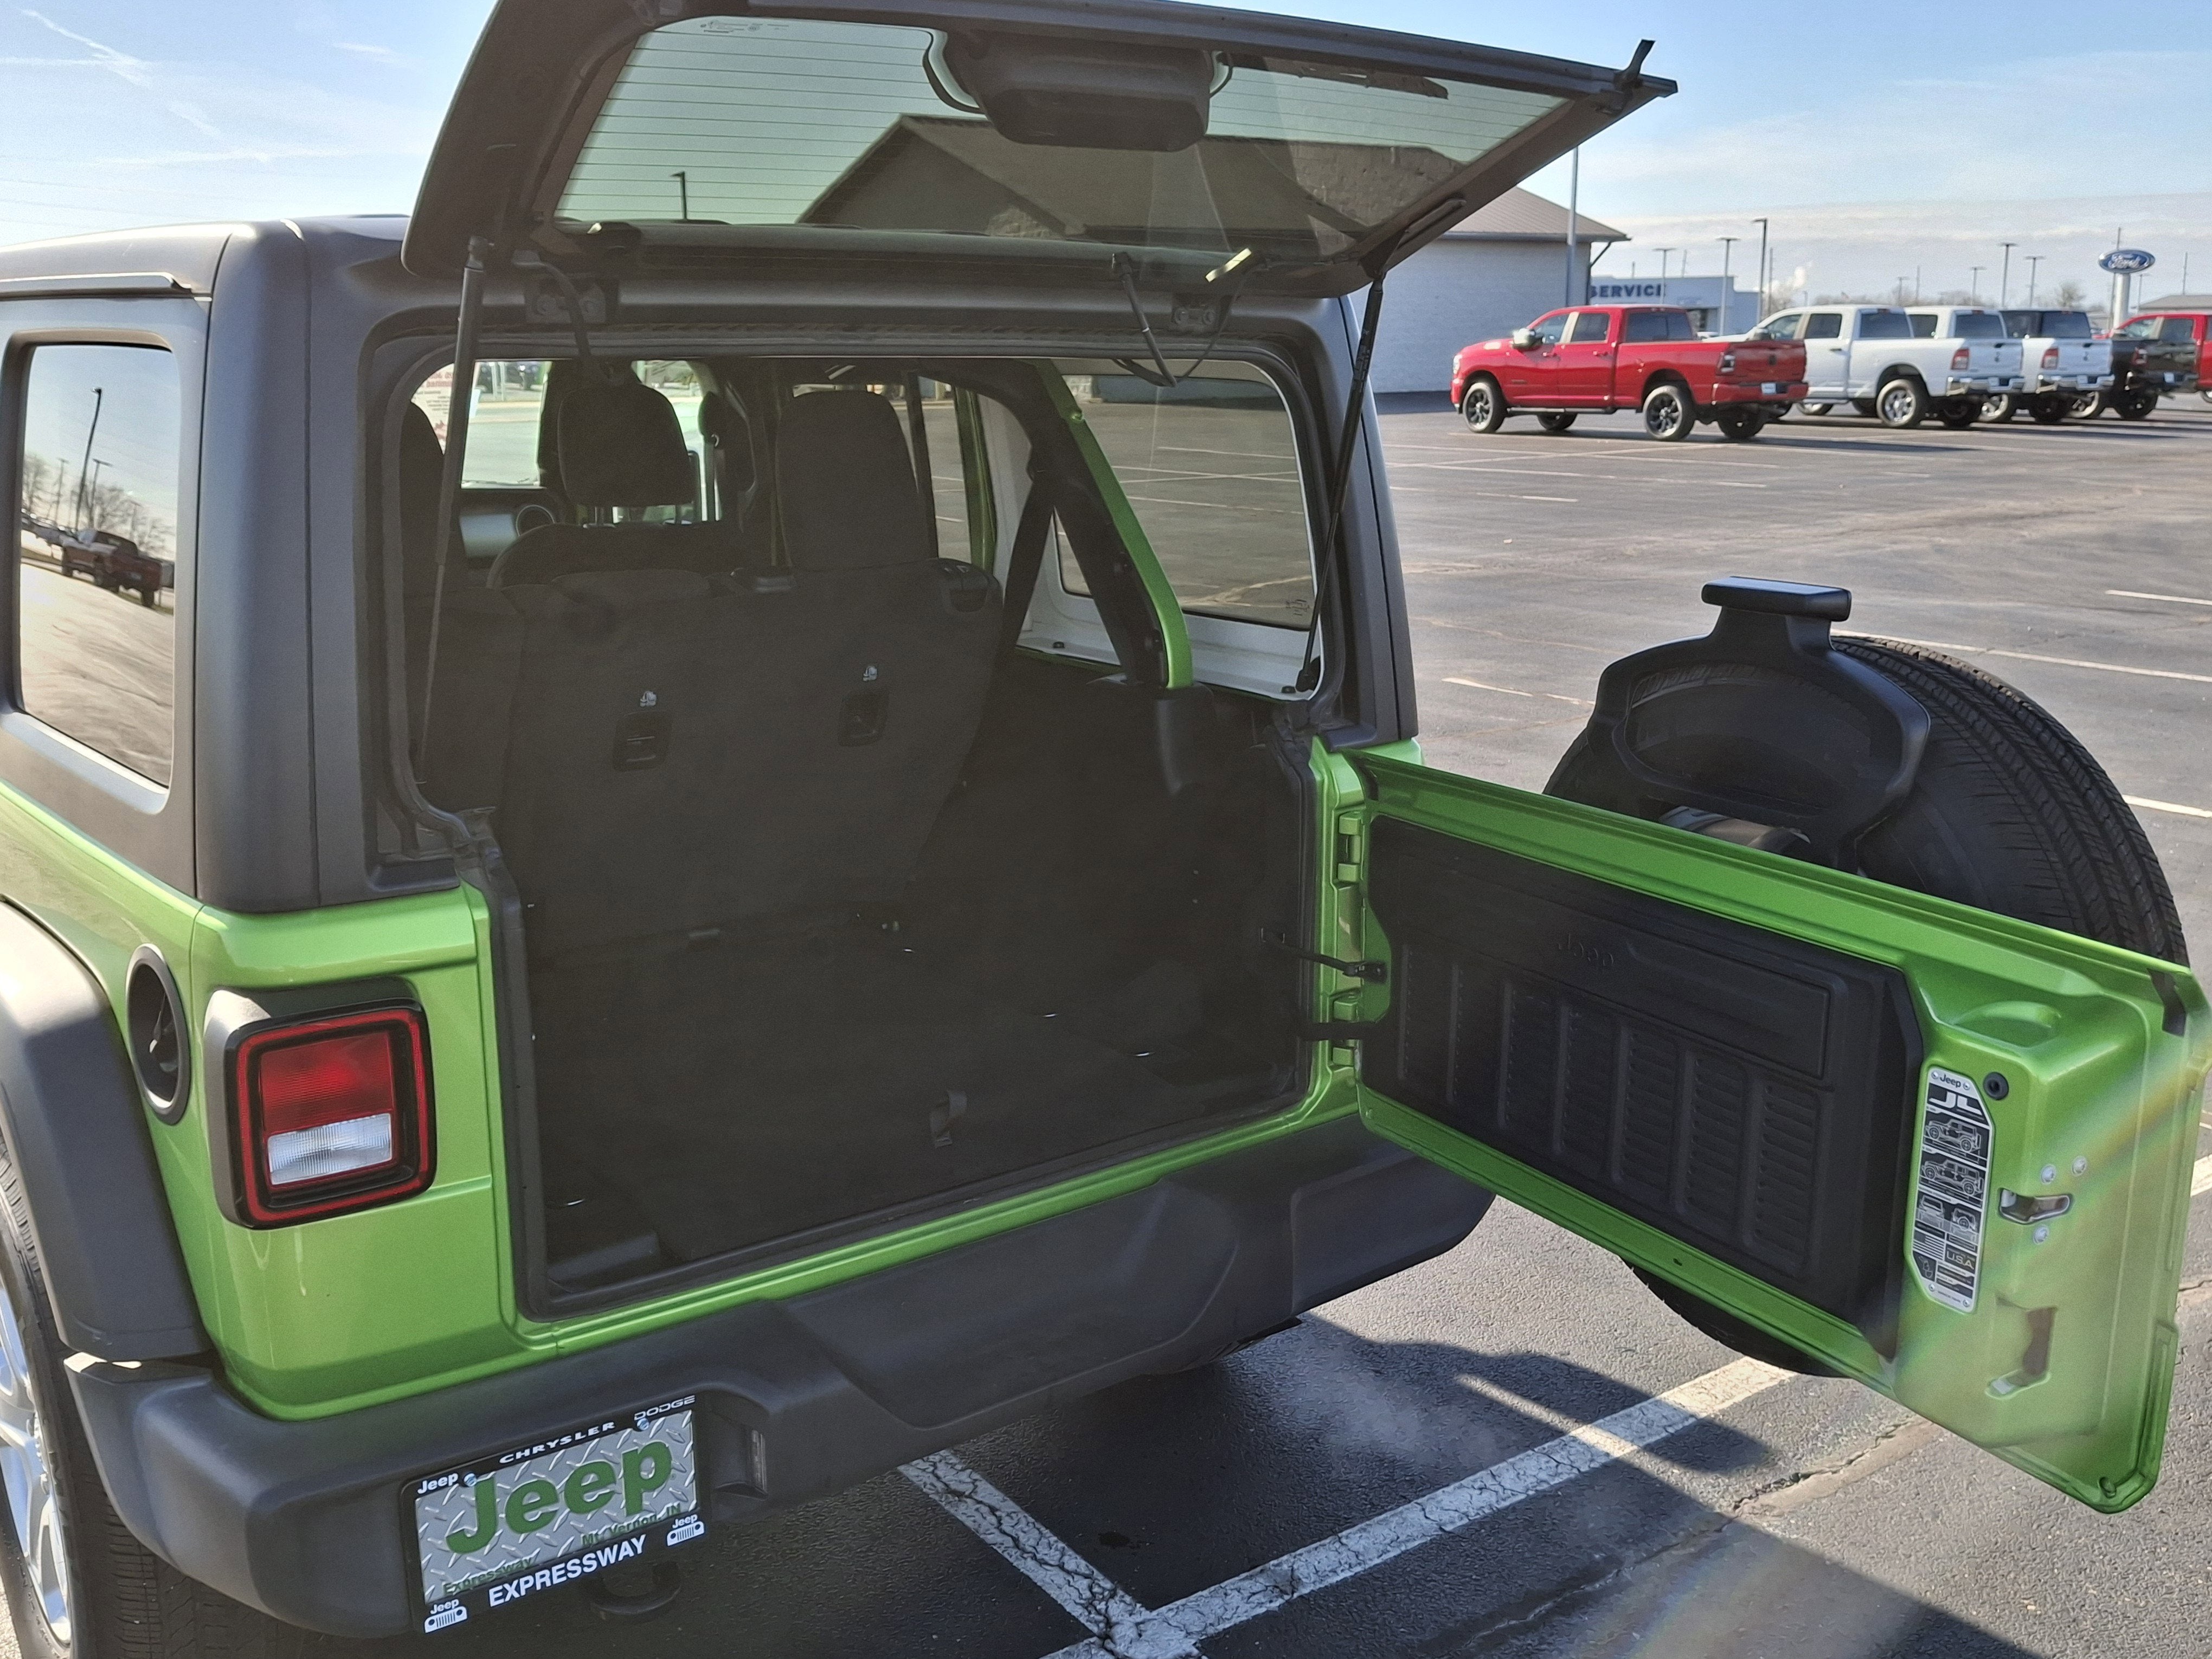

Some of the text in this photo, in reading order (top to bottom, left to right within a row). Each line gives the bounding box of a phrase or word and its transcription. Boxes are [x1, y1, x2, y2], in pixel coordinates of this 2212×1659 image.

[1939, 1074, 1961, 1088] Jeep
[634, 1396, 696, 1420] DODGE
[499, 1422, 616, 1464] CHRYSLER
[417, 1473, 459, 1494] Jeep
[445, 1441, 673, 1554] Jeep
[666, 1501, 681, 1516] IN
[672, 1514, 697, 1528] Jeep
[489, 1534, 646, 1606] EXPRESSWAY
[430, 1599, 459, 1614] Jeep
